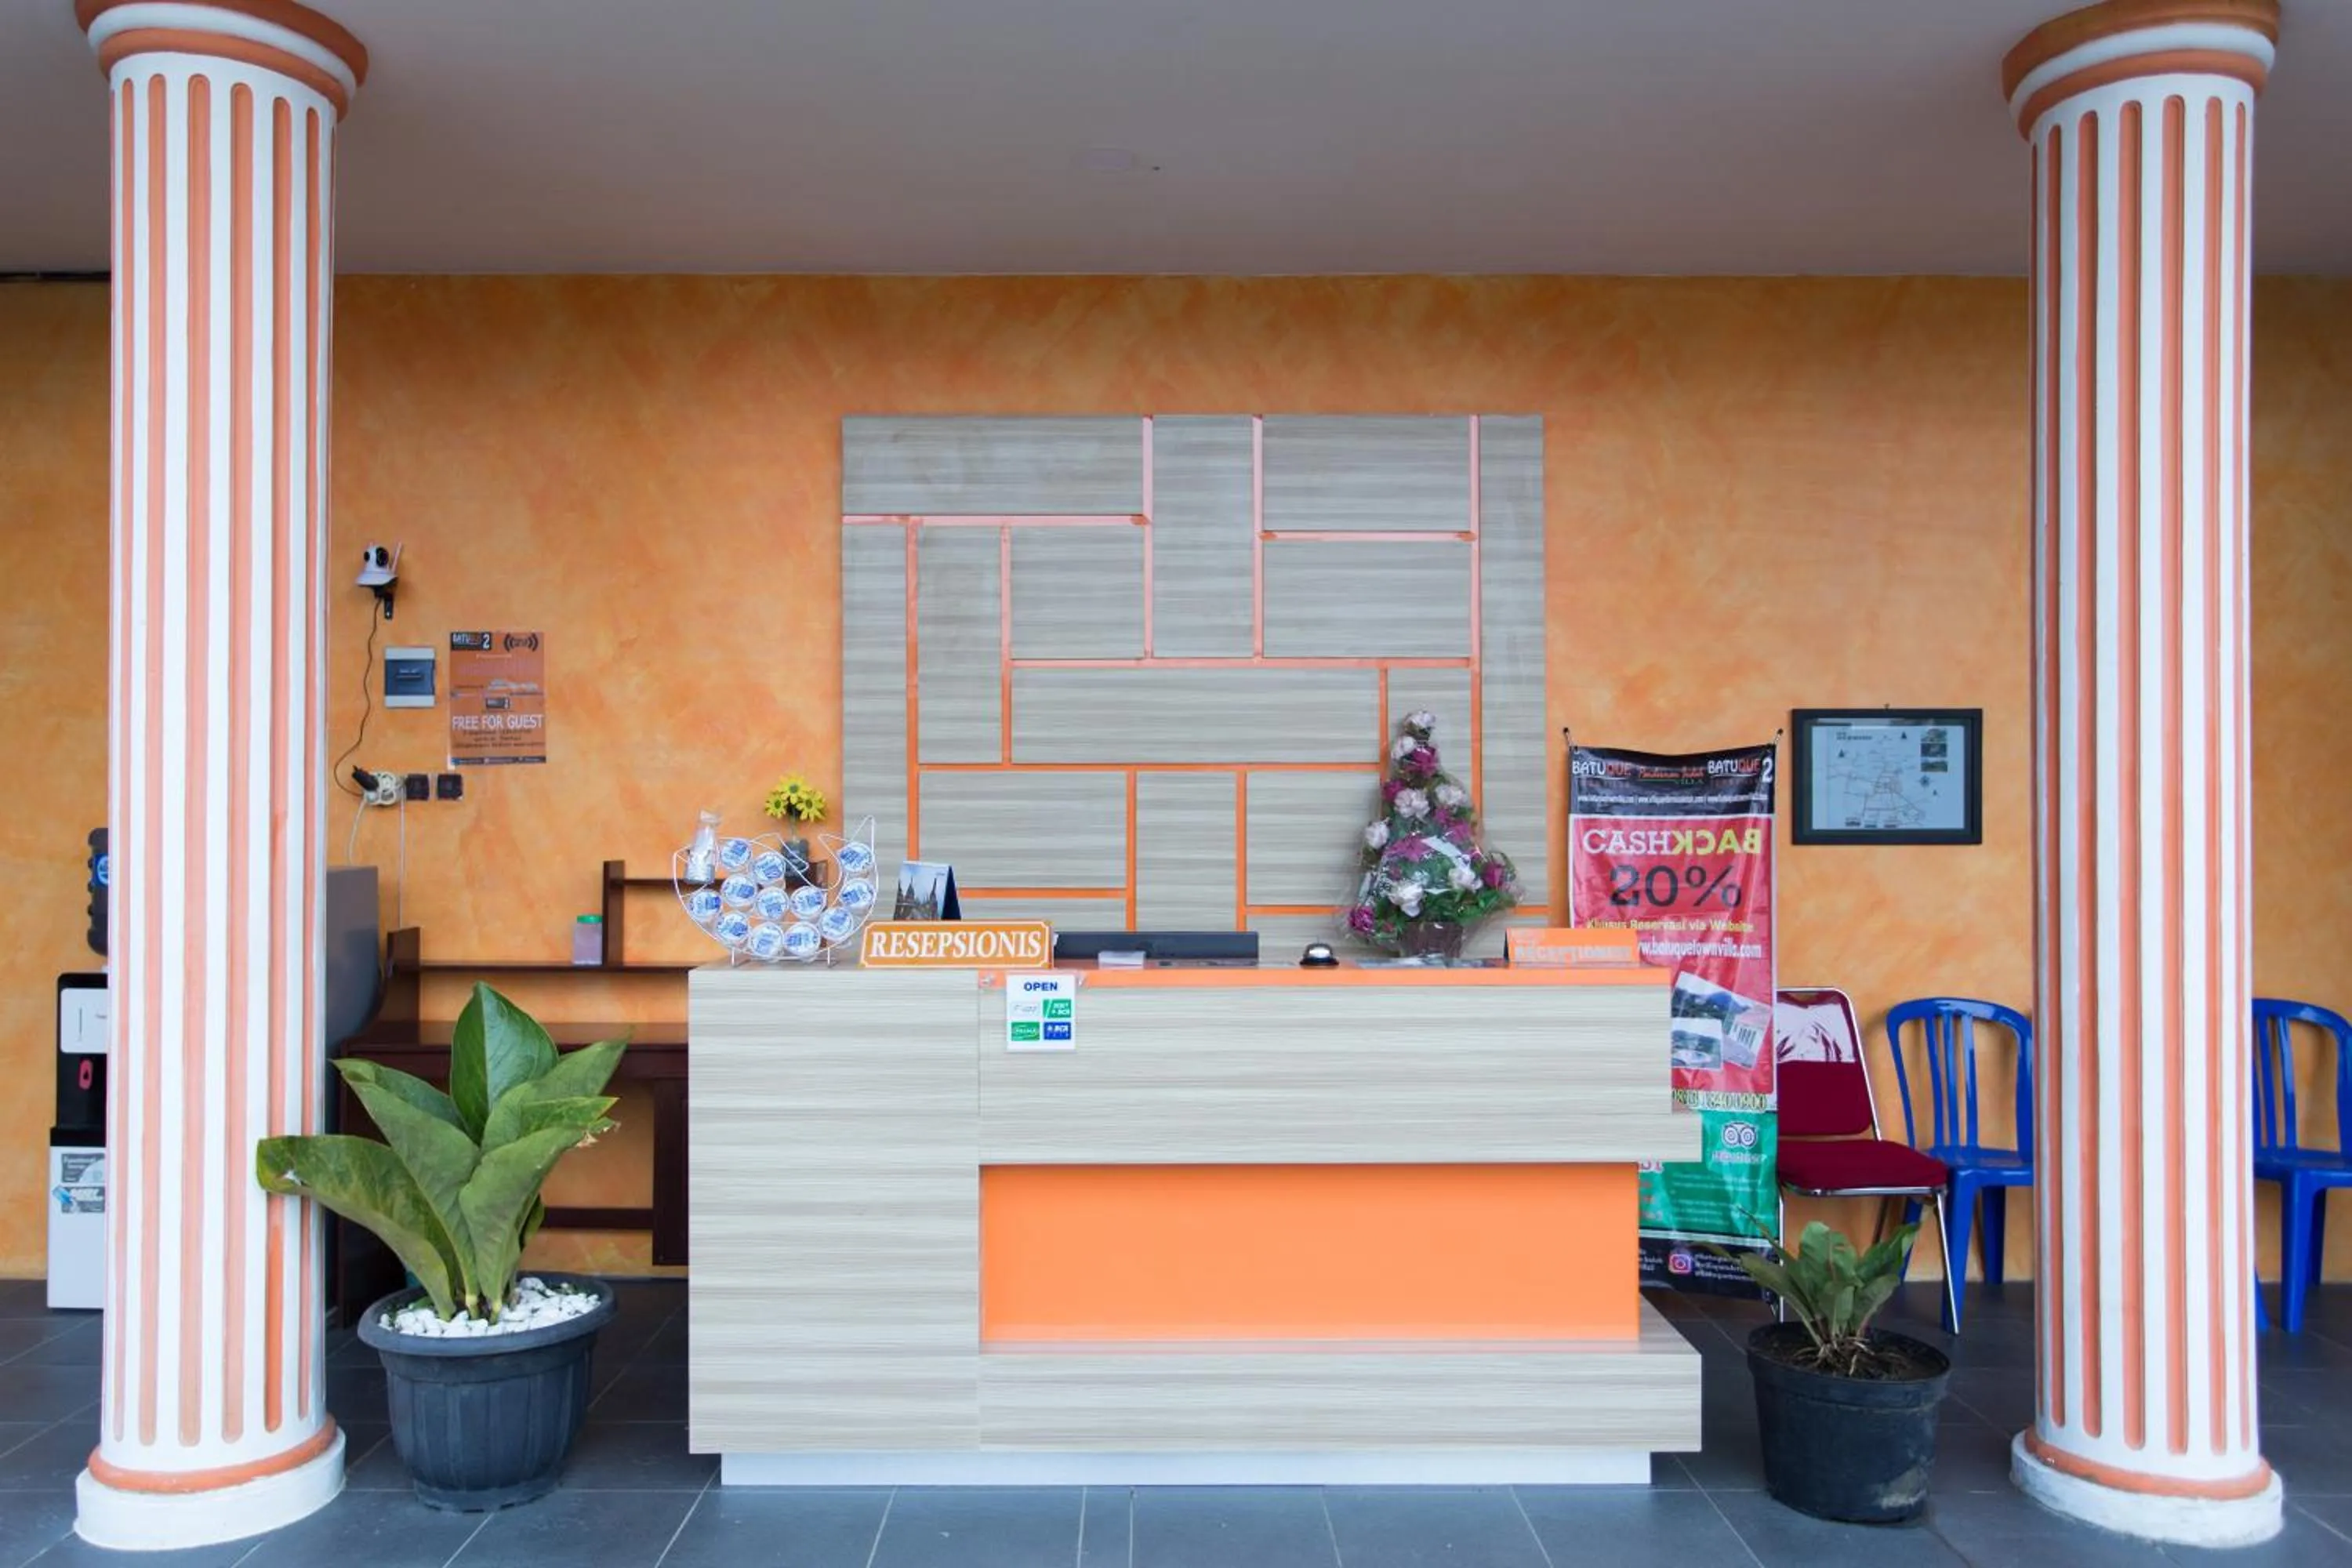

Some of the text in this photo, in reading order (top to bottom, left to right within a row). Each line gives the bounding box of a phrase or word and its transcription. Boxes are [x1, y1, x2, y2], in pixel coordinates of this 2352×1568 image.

[482, 633, 490, 648] 2
[452, 714, 543, 730] FREE FOR GUEST
[1573, 760, 1632, 775] BATUQUE
[1708, 759, 1762, 774] BATUQUE
[1762, 758, 1773, 782] 2
[1610, 865, 1741, 907] 20%
[1689, 920, 1707, 931] via
[870, 931, 1041, 957] RESEPSIONIS
[1024, 982, 1058, 991] OPEN
